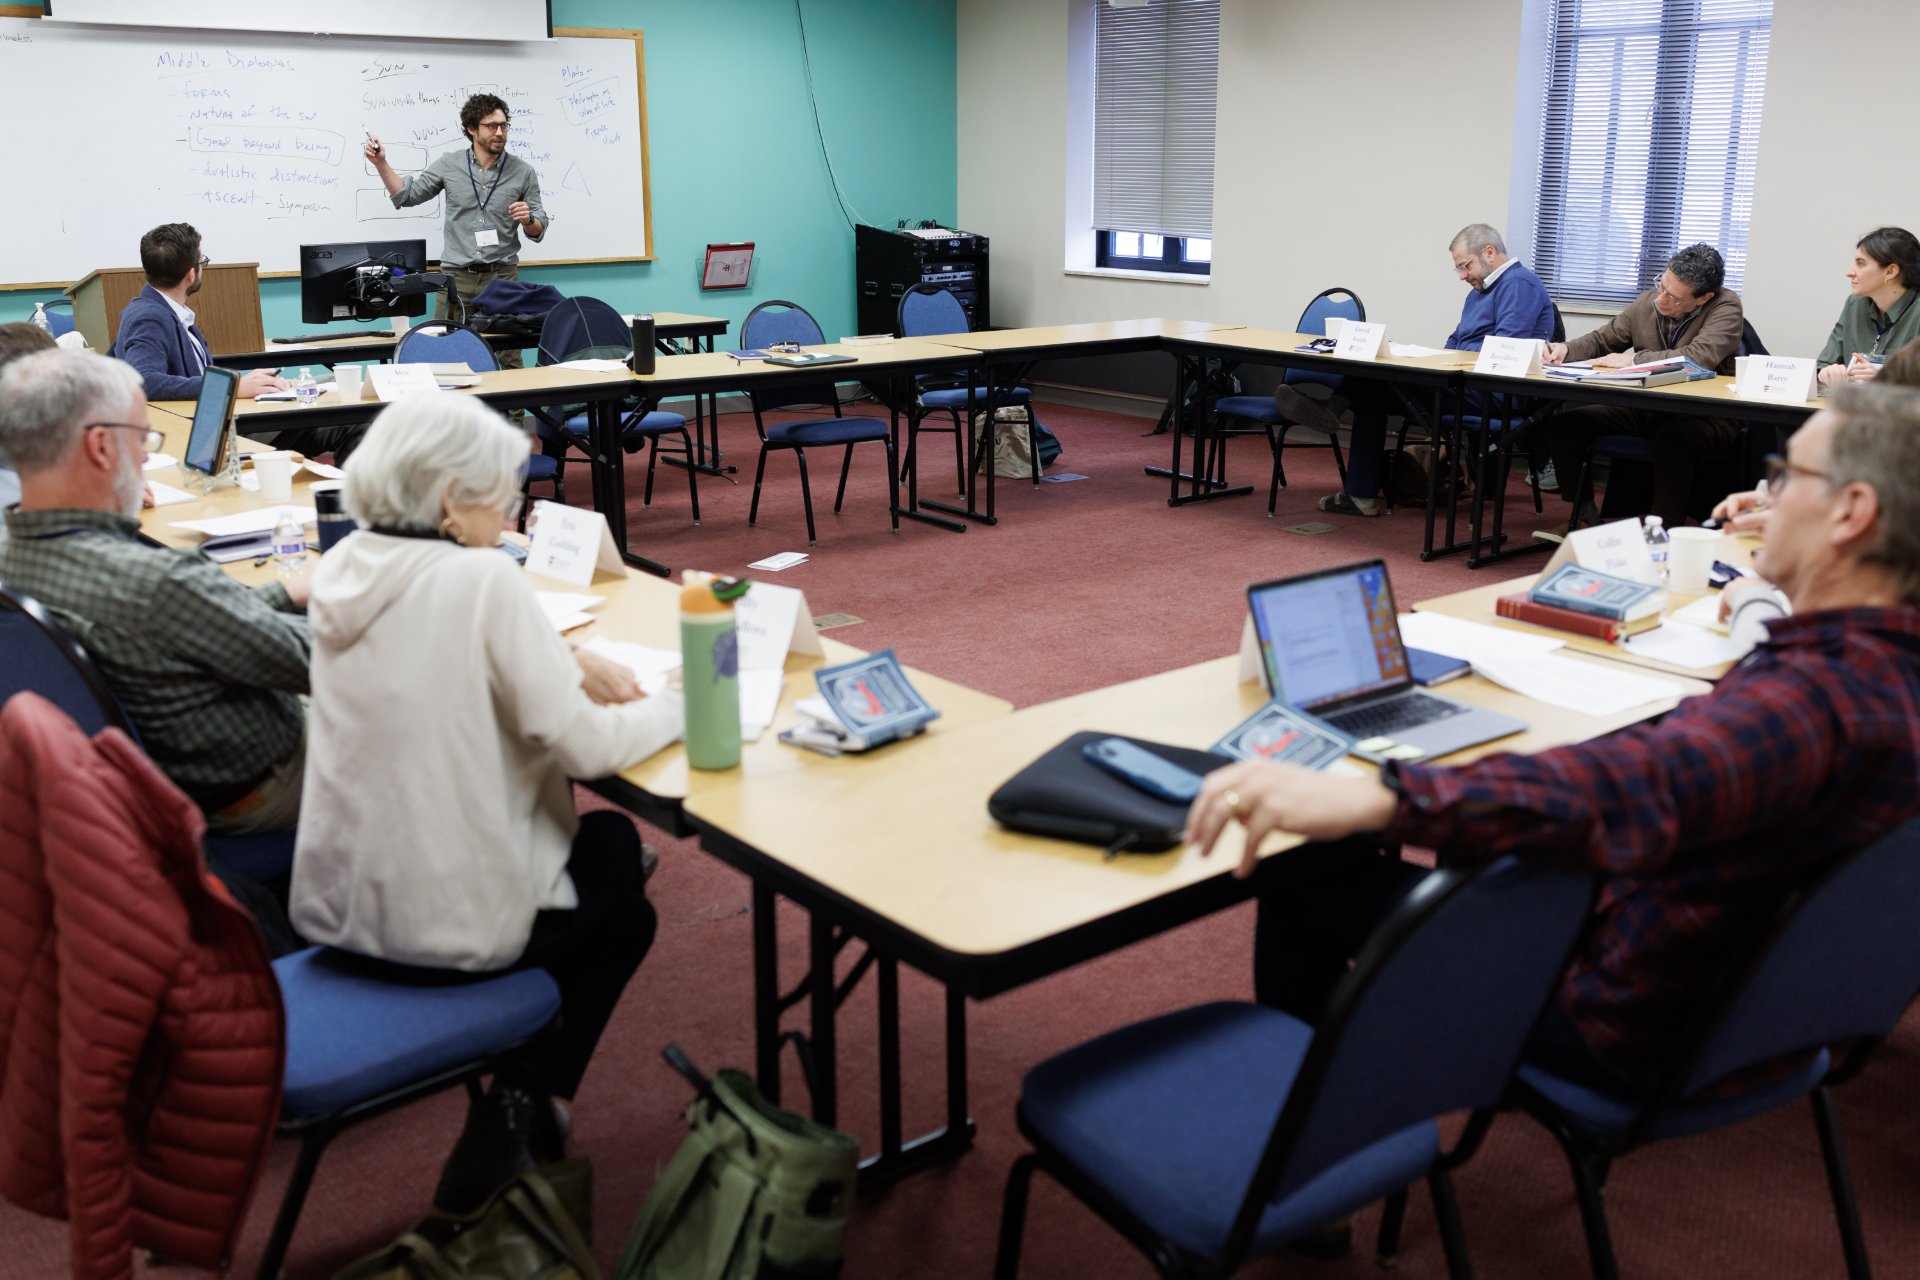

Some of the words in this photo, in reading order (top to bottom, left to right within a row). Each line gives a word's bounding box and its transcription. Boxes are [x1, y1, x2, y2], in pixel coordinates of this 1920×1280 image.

[309, 251, 334, 260] acer
[1765, 360, 1796, 371] Hannah
[1767, 373, 1789, 383] Barry
